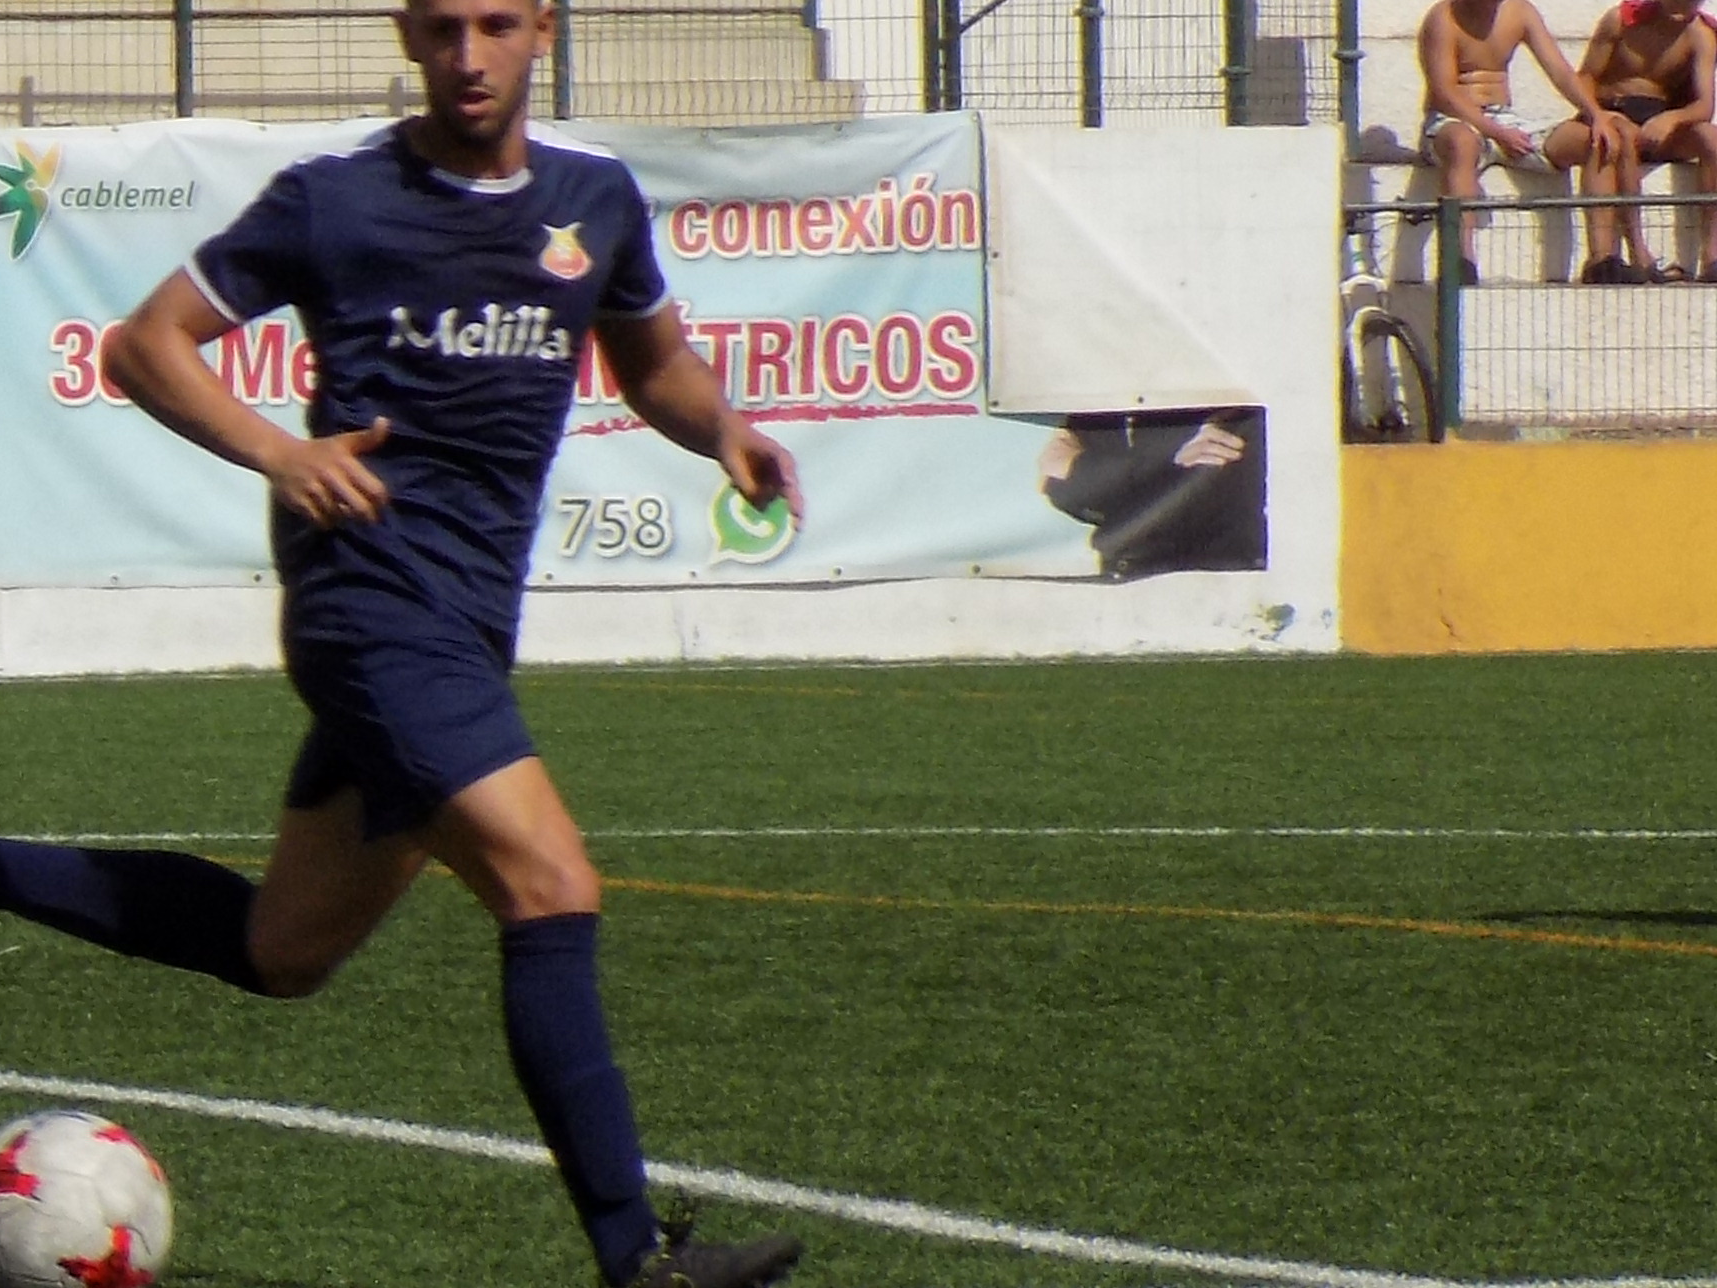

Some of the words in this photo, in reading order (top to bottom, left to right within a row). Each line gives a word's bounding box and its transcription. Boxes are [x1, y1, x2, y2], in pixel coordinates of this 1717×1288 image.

[60, 180, 195, 208] cablemel
[670, 174, 978, 254] conexión
[217, 321, 319, 402] Me
[559, 496, 667, 551] 758
